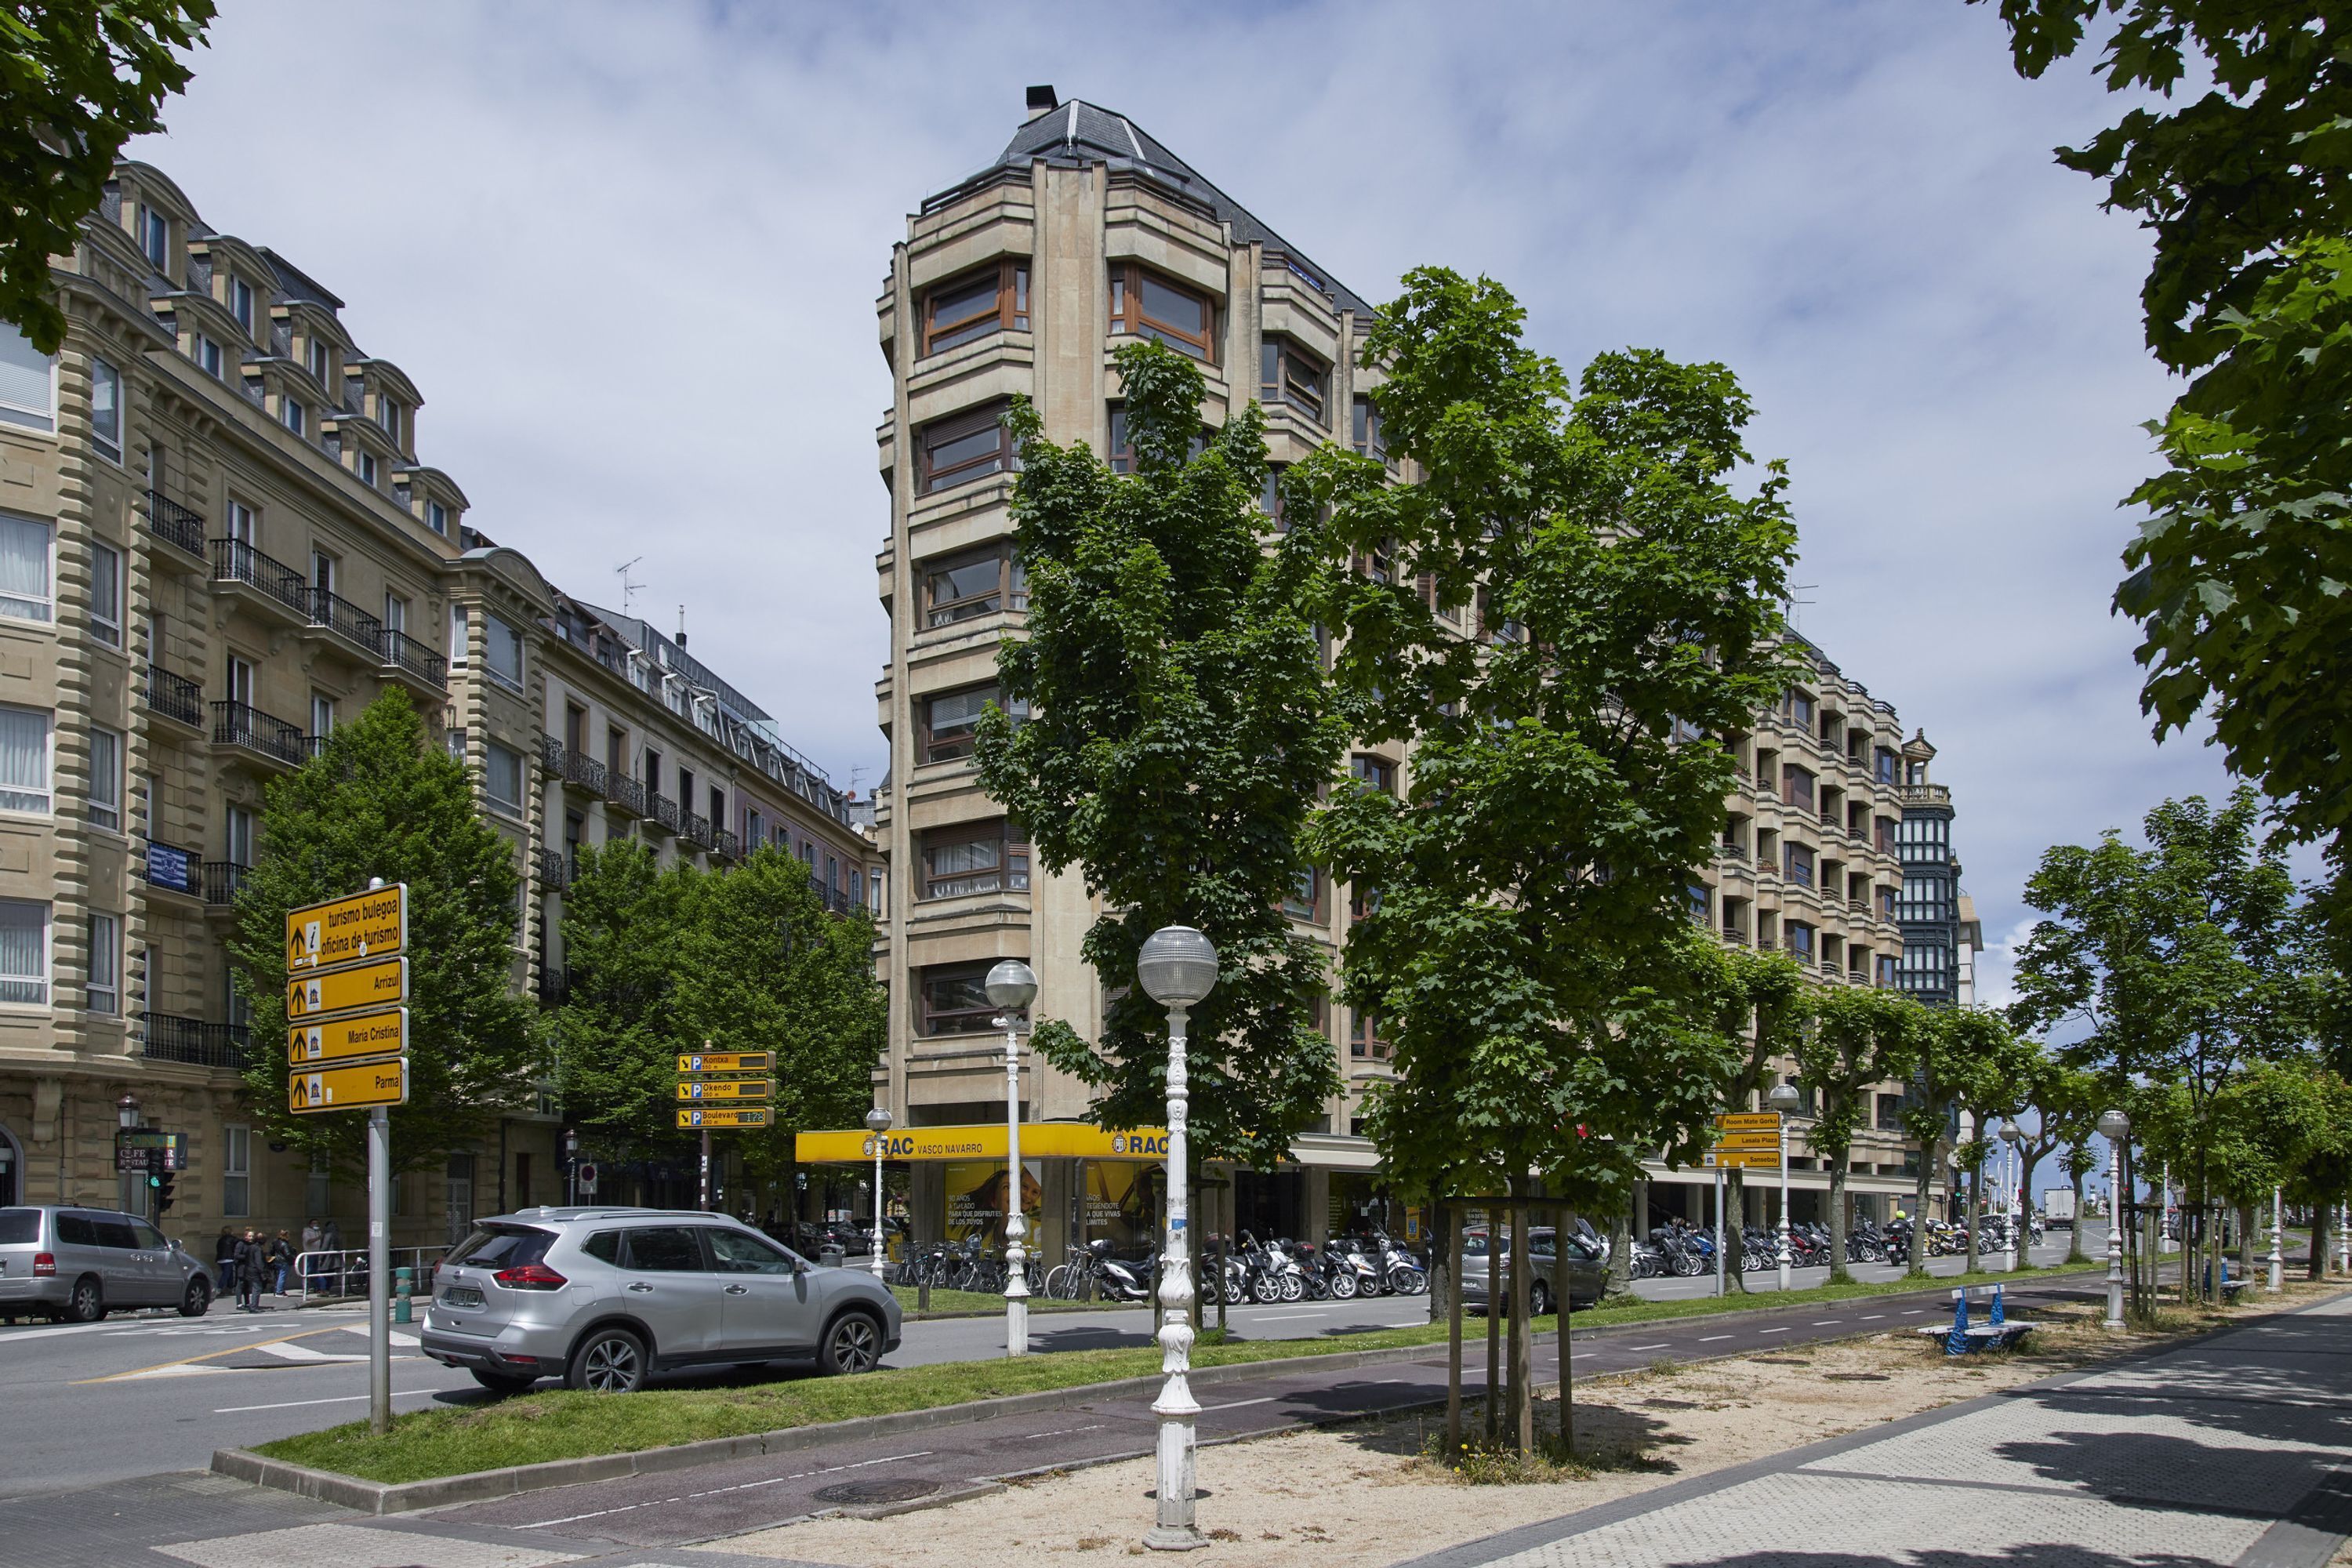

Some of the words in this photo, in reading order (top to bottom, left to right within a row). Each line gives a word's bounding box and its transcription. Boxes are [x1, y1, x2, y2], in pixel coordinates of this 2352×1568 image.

[329, 906, 360, 927] turismo
[362, 898, 397, 922] bulegoa
[321, 934, 349, 956] oficina
[352, 931, 362, 949] de
[364, 926, 398, 946] turismo
[373, 973, 399, 990] Arrizul
[348, 1029, 368, 1044] María
[370, 1025, 399, 1042] Cristina
[376, 1075, 399, 1089] Parma
[121, 1149, 146, 1158] CFE
[880, 1137, 914, 1155] RAC
[917, 1145, 942, 1154] VASCO
[946, 1143, 982, 1154] NAVARRO
[1130, 1135, 1168, 1154] RAC
